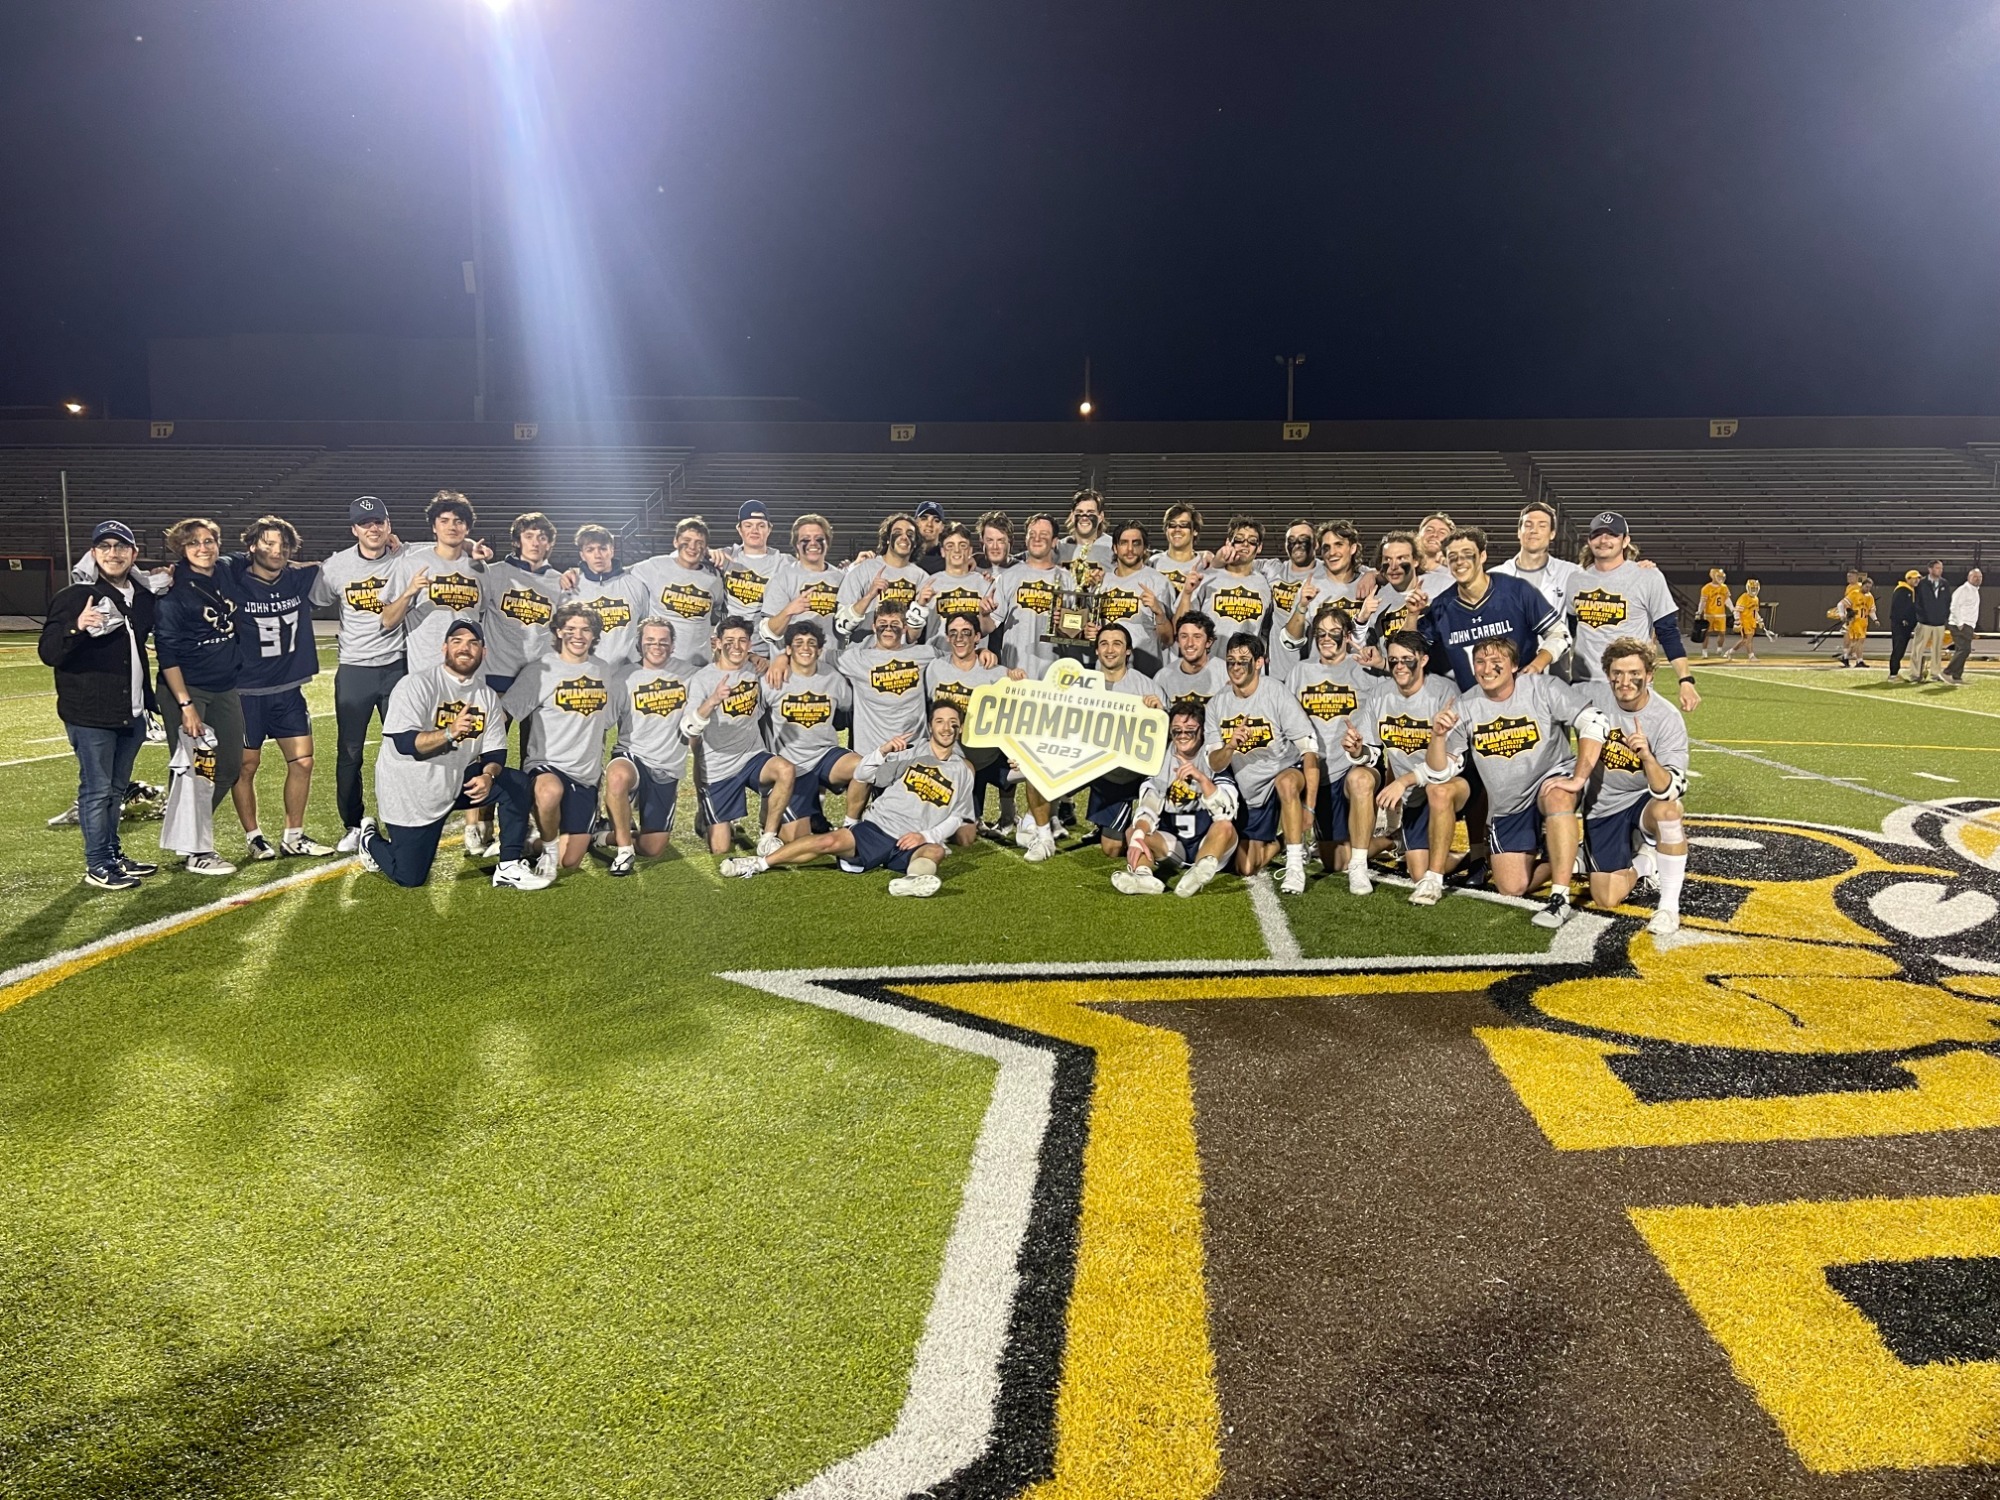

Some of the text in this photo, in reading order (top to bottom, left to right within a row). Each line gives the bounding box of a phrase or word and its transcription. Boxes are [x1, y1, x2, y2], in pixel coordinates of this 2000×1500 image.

[520, 429, 532, 438] 12
[897, 430, 909, 439] 13
[1289, 429, 1302, 438] 14
[1717, 426, 1731, 435] 15
[431, 583, 478, 602] CHAMPIONS
[245, 596, 302, 613] JOHN CARROLL
[1716, 597, 1721, 606] 6
[254, 611, 298, 658] 97
[1449, 620, 1513, 644] JOHN CARROLL
[873, 668, 919, 686] CHAMPIONS
[1060, 674, 1097, 689] OAC
[558, 689, 607, 704] CHAMPIONS
[637, 687, 685, 709] CHAMPIONS
[1005, 686, 1136, 712] OHIO ATHLETIC CONFERENCE
[1303, 693, 1355, 709] CHAMPIONS
[783, 702, 830, 716] CHAMPIONS
[975, 695, 1157, 762] CHAMPIONS
[1474, 724, 1537, 750] CHAMPIONS
[1036, 742, 1082, 758] 2023
